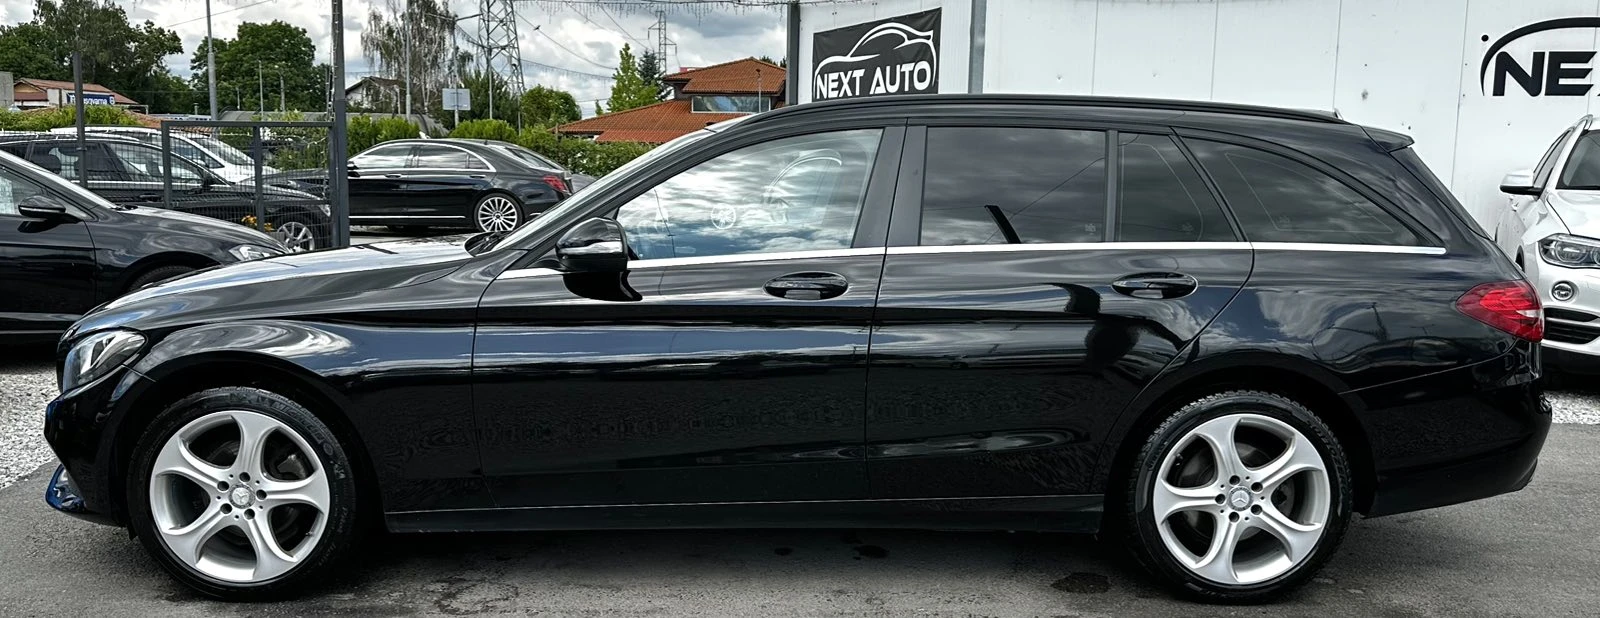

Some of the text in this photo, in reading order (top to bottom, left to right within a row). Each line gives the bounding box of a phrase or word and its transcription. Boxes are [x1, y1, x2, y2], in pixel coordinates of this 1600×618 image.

[816, 60, 931, 99] NEXT AUTO
[1492, 51, 1600, 97] NE
